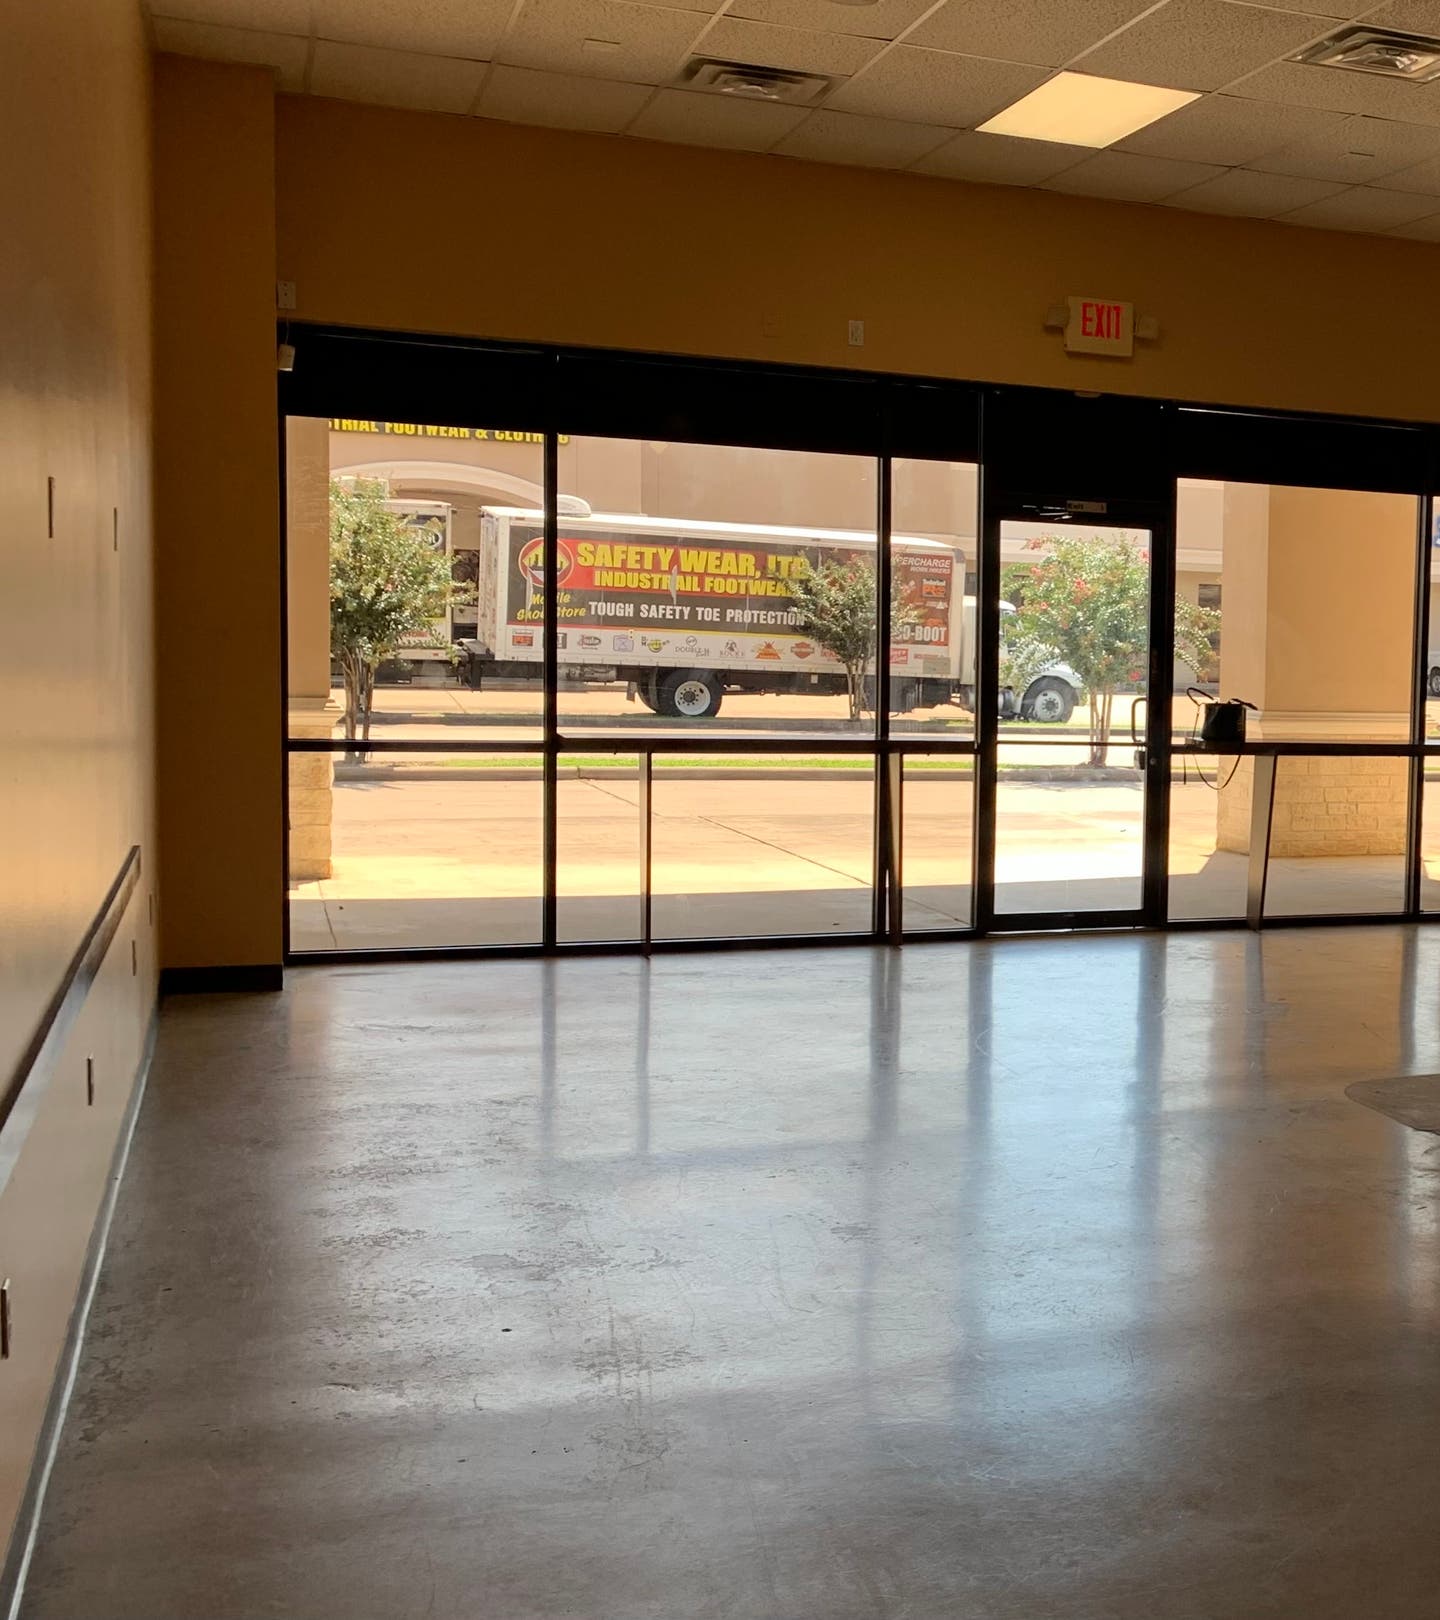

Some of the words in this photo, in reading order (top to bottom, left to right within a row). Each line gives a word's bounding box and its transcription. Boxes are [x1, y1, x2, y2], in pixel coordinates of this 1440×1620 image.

[1081, 302, 1124, 340] EXIT
[577, 543, 674, 571] SAFETY
[680, 549, 761, 579] WEAR,
[704, 576, 794, 597] FOOTWEA
[588, 601, 634, 617] TOUGH
[640, 604, 691, 620] SAFETY
[695, 607, 721, 621] TOE
[726, 609, 805, 626] PROTECTION
